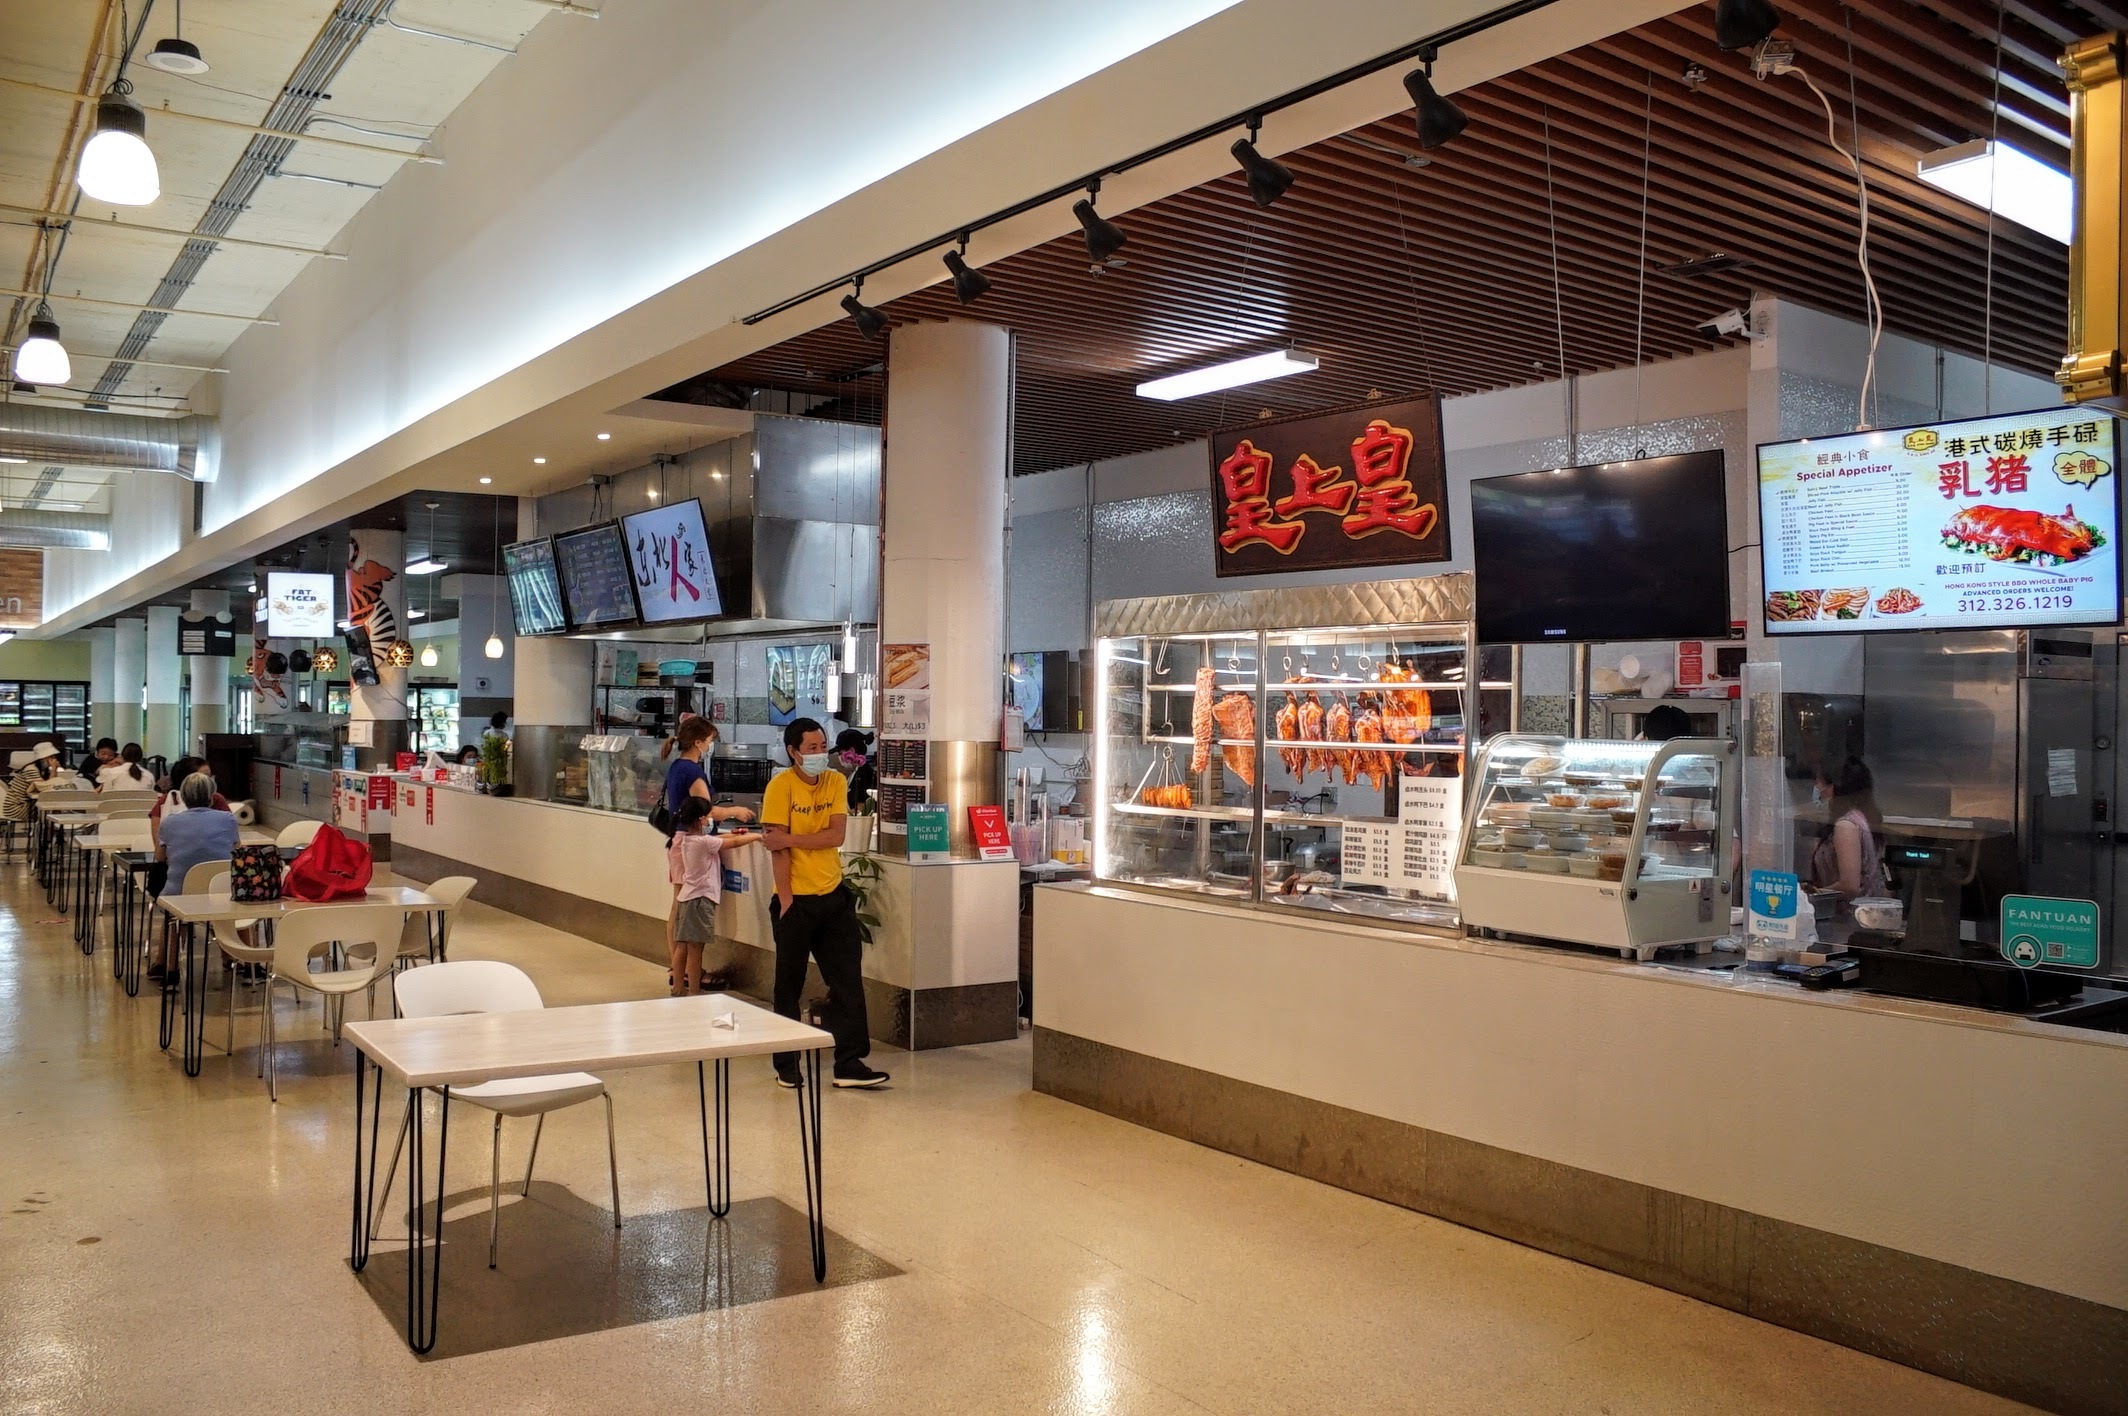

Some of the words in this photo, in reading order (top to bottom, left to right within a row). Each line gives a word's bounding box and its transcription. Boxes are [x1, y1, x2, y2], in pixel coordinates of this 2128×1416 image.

[1817, 449, 1869, 465] 經典小食
[1797, 469, 1834, 481] Special
[1838, 464, 1892, 477] Appetizer
[2060, 459, 2097, 475] 全體
[1218, 419, 1438, 555] 皇上皇
[1936, 563, 1986, 575] 歡迎預訂
[1958, 595, 2072, 612] 312.326.1219
[791, 802, 811, 815] Keep
[1755, 882, 1793, 896] 明星餐厅
[2009, 909, 2091, 924] FANTUAN
